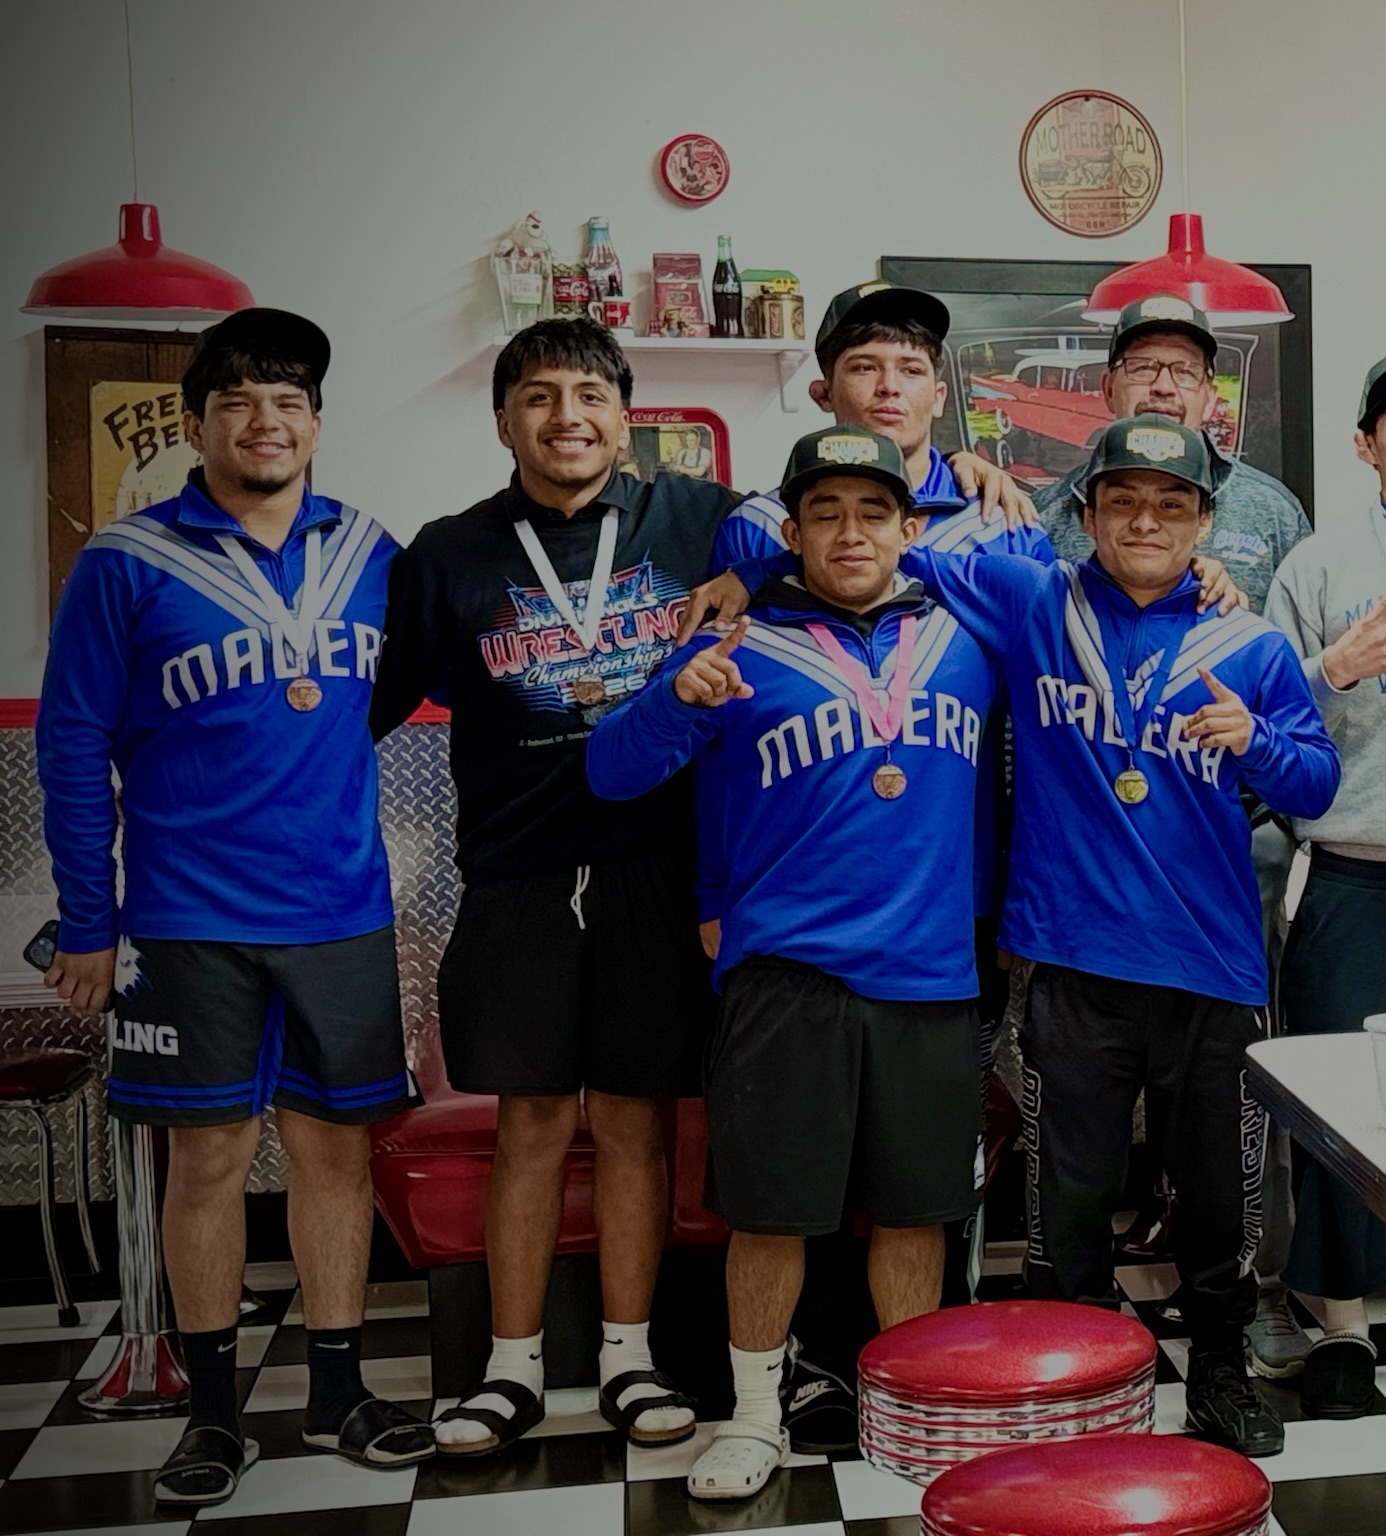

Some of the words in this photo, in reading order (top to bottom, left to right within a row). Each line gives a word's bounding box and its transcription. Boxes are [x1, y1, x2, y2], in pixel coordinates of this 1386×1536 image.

[1036, 121, 1100, 156] MOTHER
[1103, 121, 1147, 154] ROAD
[103, 391, 186, 451] FRE
[127, 421, 190, 473] BE
[162, 617, 382, 709] MADER
[795, 1380, 829, 1403] NIKE
